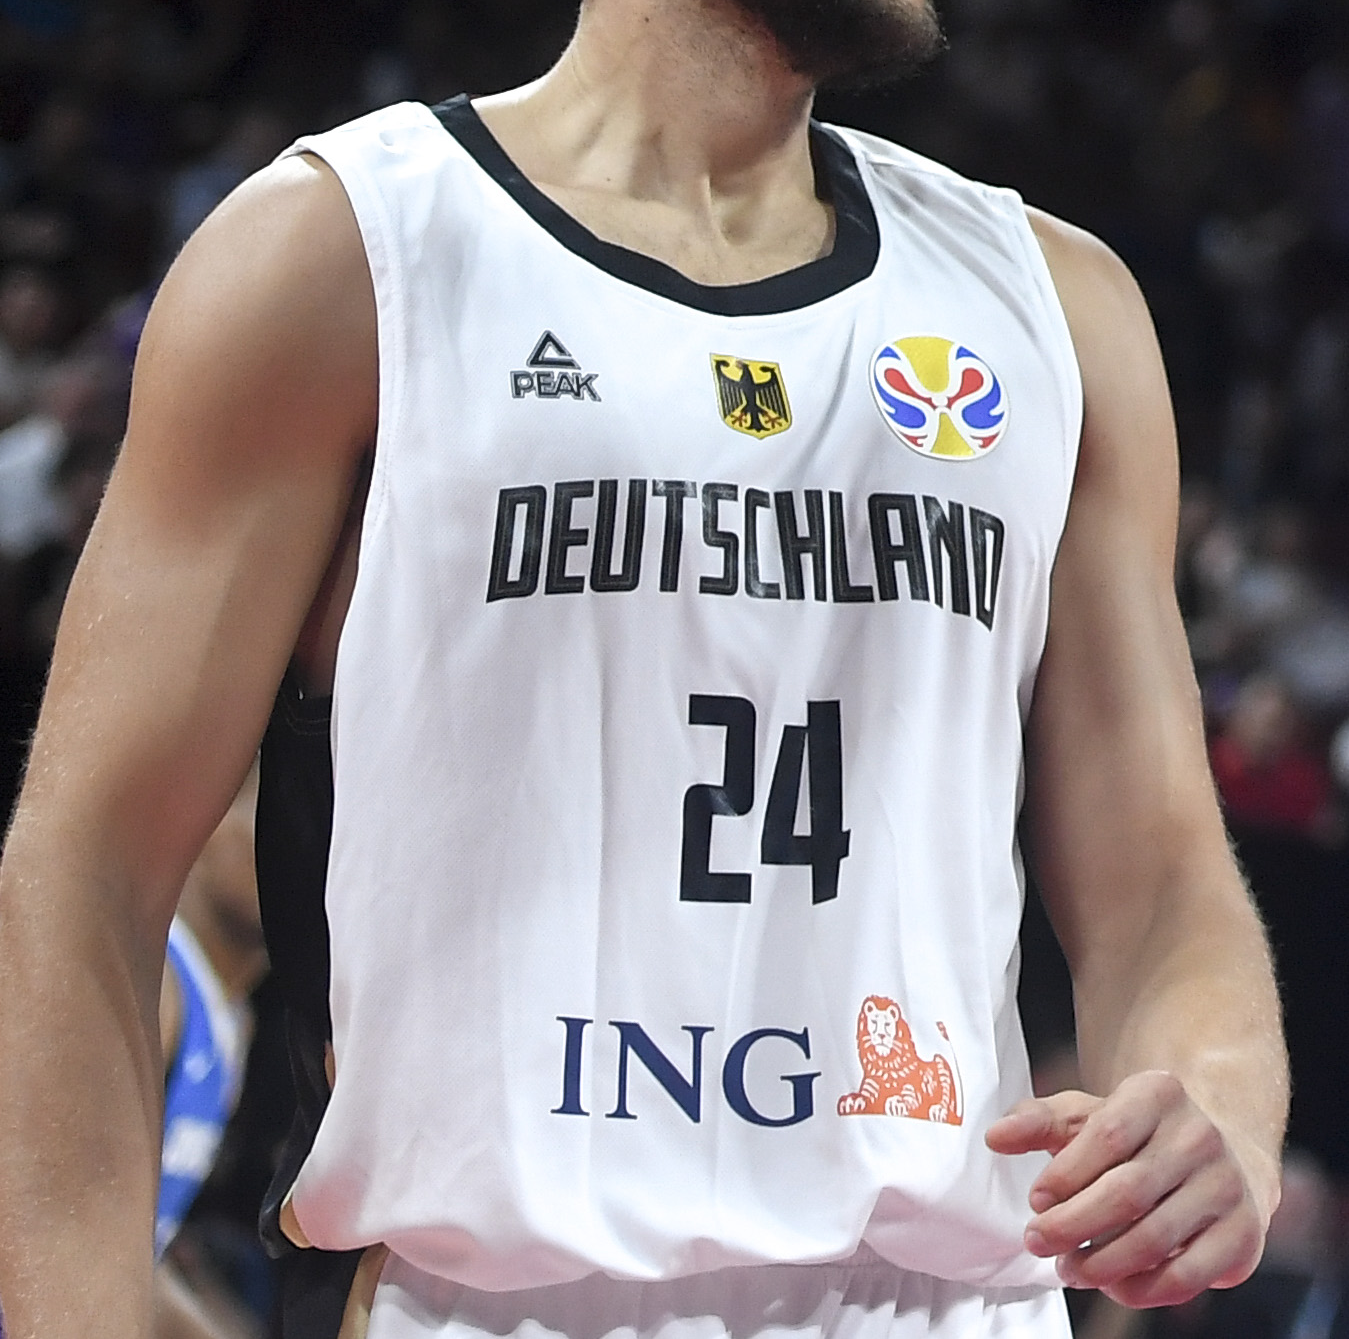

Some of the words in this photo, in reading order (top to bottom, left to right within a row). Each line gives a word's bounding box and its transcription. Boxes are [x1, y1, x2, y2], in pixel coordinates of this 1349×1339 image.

[511, 370, 602, 402] PEAK
[485, 477, 1006, 632] DEUTSCHLAND
[679, 693, 852, 906] 24
[550, 1015, 822, 1128] ING
